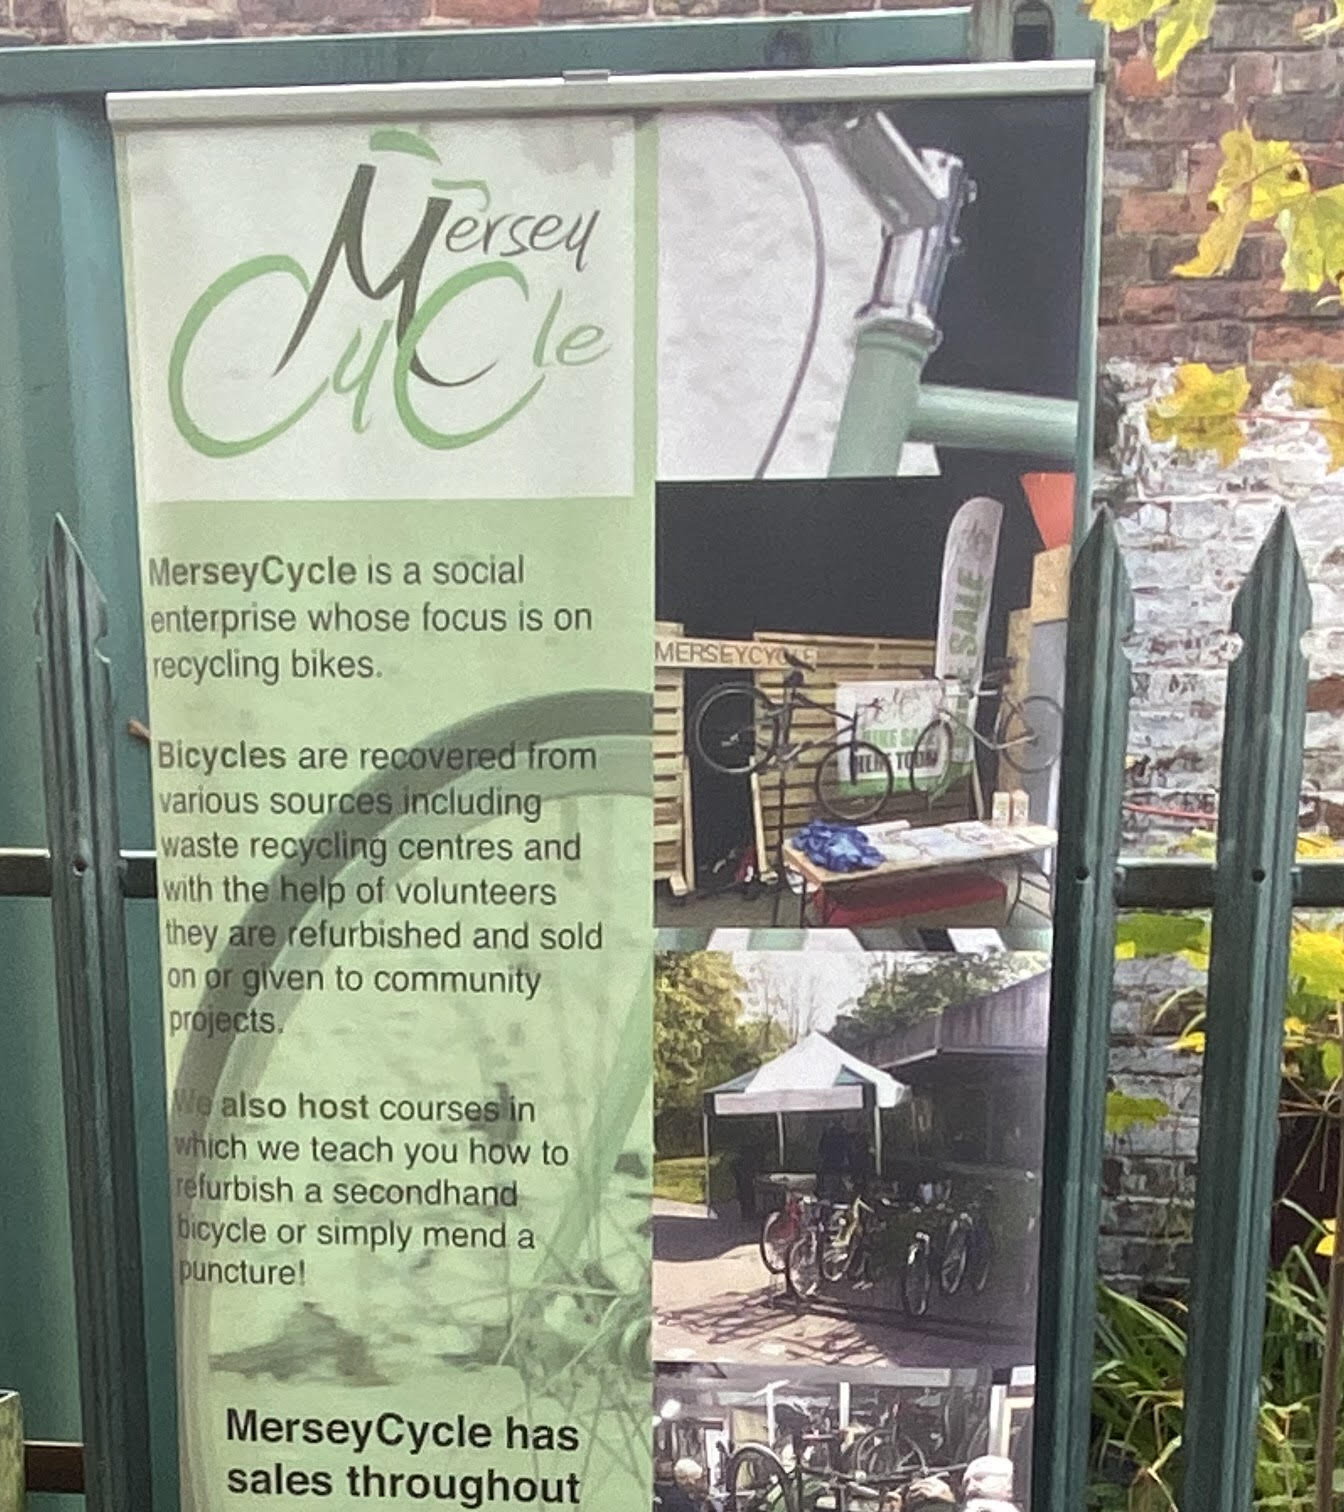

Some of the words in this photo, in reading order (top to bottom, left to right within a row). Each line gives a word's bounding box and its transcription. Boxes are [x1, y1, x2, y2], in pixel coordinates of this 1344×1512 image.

[272, 164, 601, 388] Mersey
[149, 555, 357, 594] MerseyCycle
[367, 555, 392, 585] is
[402, 561, 422, 586] a
[432, 554, 525, 586] social
[151, 602, 297, 639] enterprise
[309, 603, 411, 632] whose
[422, 601, 508, 632] focus
[518, 602, 544, 632] is
[553, 608, 593, 632] on
[153, 649, 280, 685] recycling
[291, 648, 384, 680] bikes.
[158, 740, 288, 775] Bicycles
[298, 747, 348, 770] are
[360, 741, 516, 771] recovered
[527, 741, 597, 770] from
[159, 784, 259, 816] various
[270, 788, 393, 816] sources
[404, 785, 543, 823] including
[161, 831, 239, 860] waste
[250, 832, 388, 867] recycling
[399, 834, 514, 862] centres
[524, 832, 582, 862] and
[162, 874, 213, 902] with
[223, 876, 268, 903] the
[280, 876, 346, 911] help
[356, 877, 385, 906] of
[396, 879, 557, 906] volunteers
[165, 918, 219, 951] they
[229, 925, 276, 948] are
[287, 920, 462, 950] refurbished
[472, 922, 529, 951] and
[540, 922, 603, 951] sold
[167, 965, 196, 989] on
[205, 967, 233, 989] or
[242, 965, 325, 997] given
[336, 965, 363, 993] to
[373, 966, 543, 1000] community
[169, 1007, 285, 1037] projects.
[221, 1092, 287, 1120] also
[299, 1092, 371, 1121] host
[379, 1097, 500, 1124] courses
[509, 1094, 536, 1123] in
[173, 1132, 248, 1161] which
[258, 1139, 300, 1162] we
[311, 1135, 394, 1164] teach
[404, 1142, 458, 1170] you
[468, 1137, 531, 1166] how
[542, 1139, 569, 1167] to
[175, 1172, 295, 1204] refurbish
[305, 1182, 324, 1205] a
[332, 1177, 519, 1208] secondhand
[177, 1212, 267, 1250] bicycle
[276, 1220, 308, 1244] or
[316, 1217, 414, 1253] simply
[423, 1219, 507, 1248] mend
[517, 1226, 536, 1250] a
[178, 1257, 307, 1288] puncture!
[226, 1407, 493, 1456] MerseyCycle
[506, 1415, 580, 1451] has
[226, 1463, 333, 1496] sales
[347, 1465, 581, 1508] throughout
